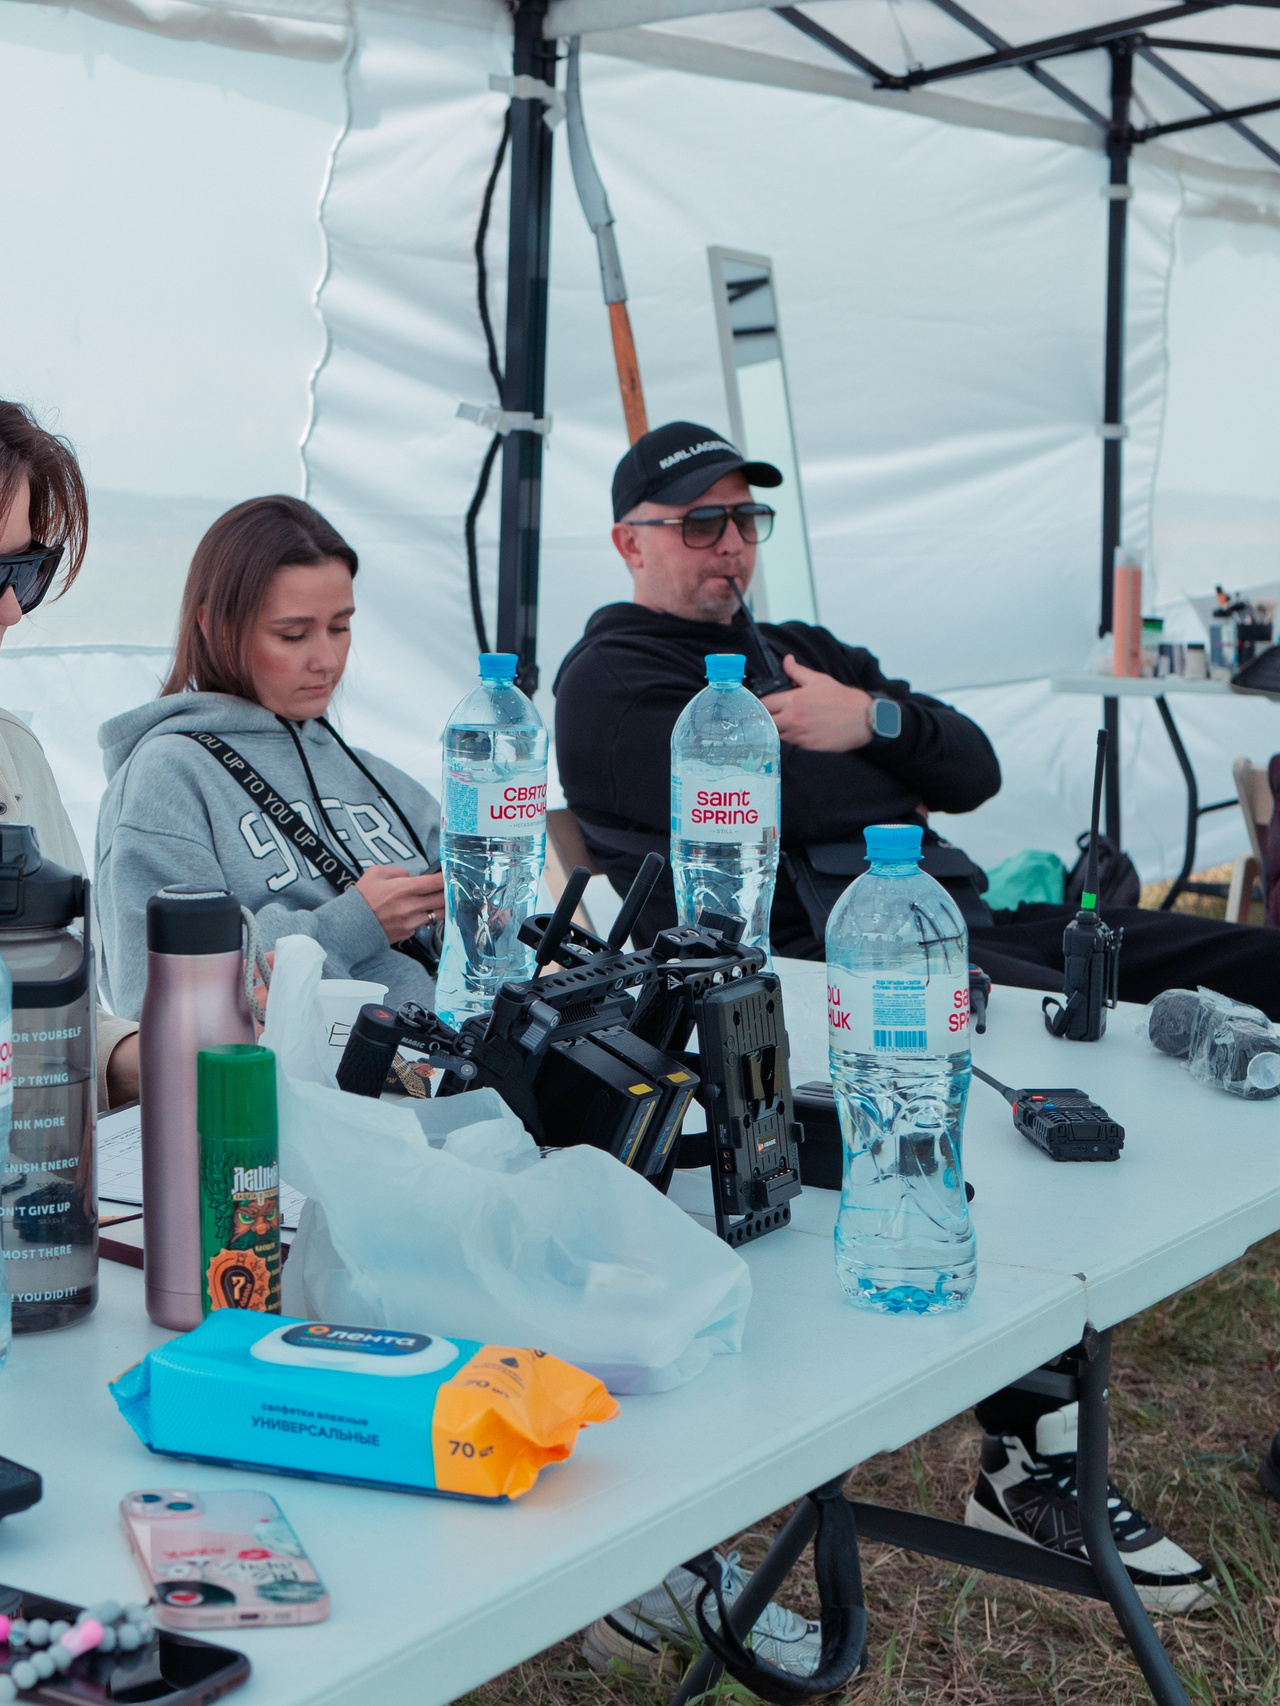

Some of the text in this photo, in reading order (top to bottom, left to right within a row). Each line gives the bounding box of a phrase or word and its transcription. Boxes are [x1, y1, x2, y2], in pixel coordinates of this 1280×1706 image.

[659, 449, 692, 470] KARL
[503, 783, 547, 802] СВЯТО
[223, 751, 245, 769] UP
[243, 771, 265, 794] TO
[263, 792, 294, 825] YOU
[294, 826, 317, 847] UP
[315, 848, 338, 873] TO
[490, 803, 547, 820] ИСТОЧН
[11, 1026, 82, 1043] OR YOURSELF
[400, 1036, 426, 1049] MAGIC
[28, 1072, 69, 1086] TRYING
[34, 1116, 65, 1129] MORE
[41, 1156, 79, 1171] ENERGY
[28, 1204, 55, 1216] GIVE
[56, 1202, 71, 1213] UP
[38, 1244, 72, 1258] THERE
[17, 1291, 41, 1302] YOU
[44, 1288, 62, 1300] DID
[64, 1286, 78, 1297] IT!
[327, 1330, 417, 1347] лента
[261, 1403, 368, 1427] салфетки влажные
[251, 1415, 381, 1447] УНИВЕРСАЛЬНЫЕ
[448, 1440, 476, 1458] 70
